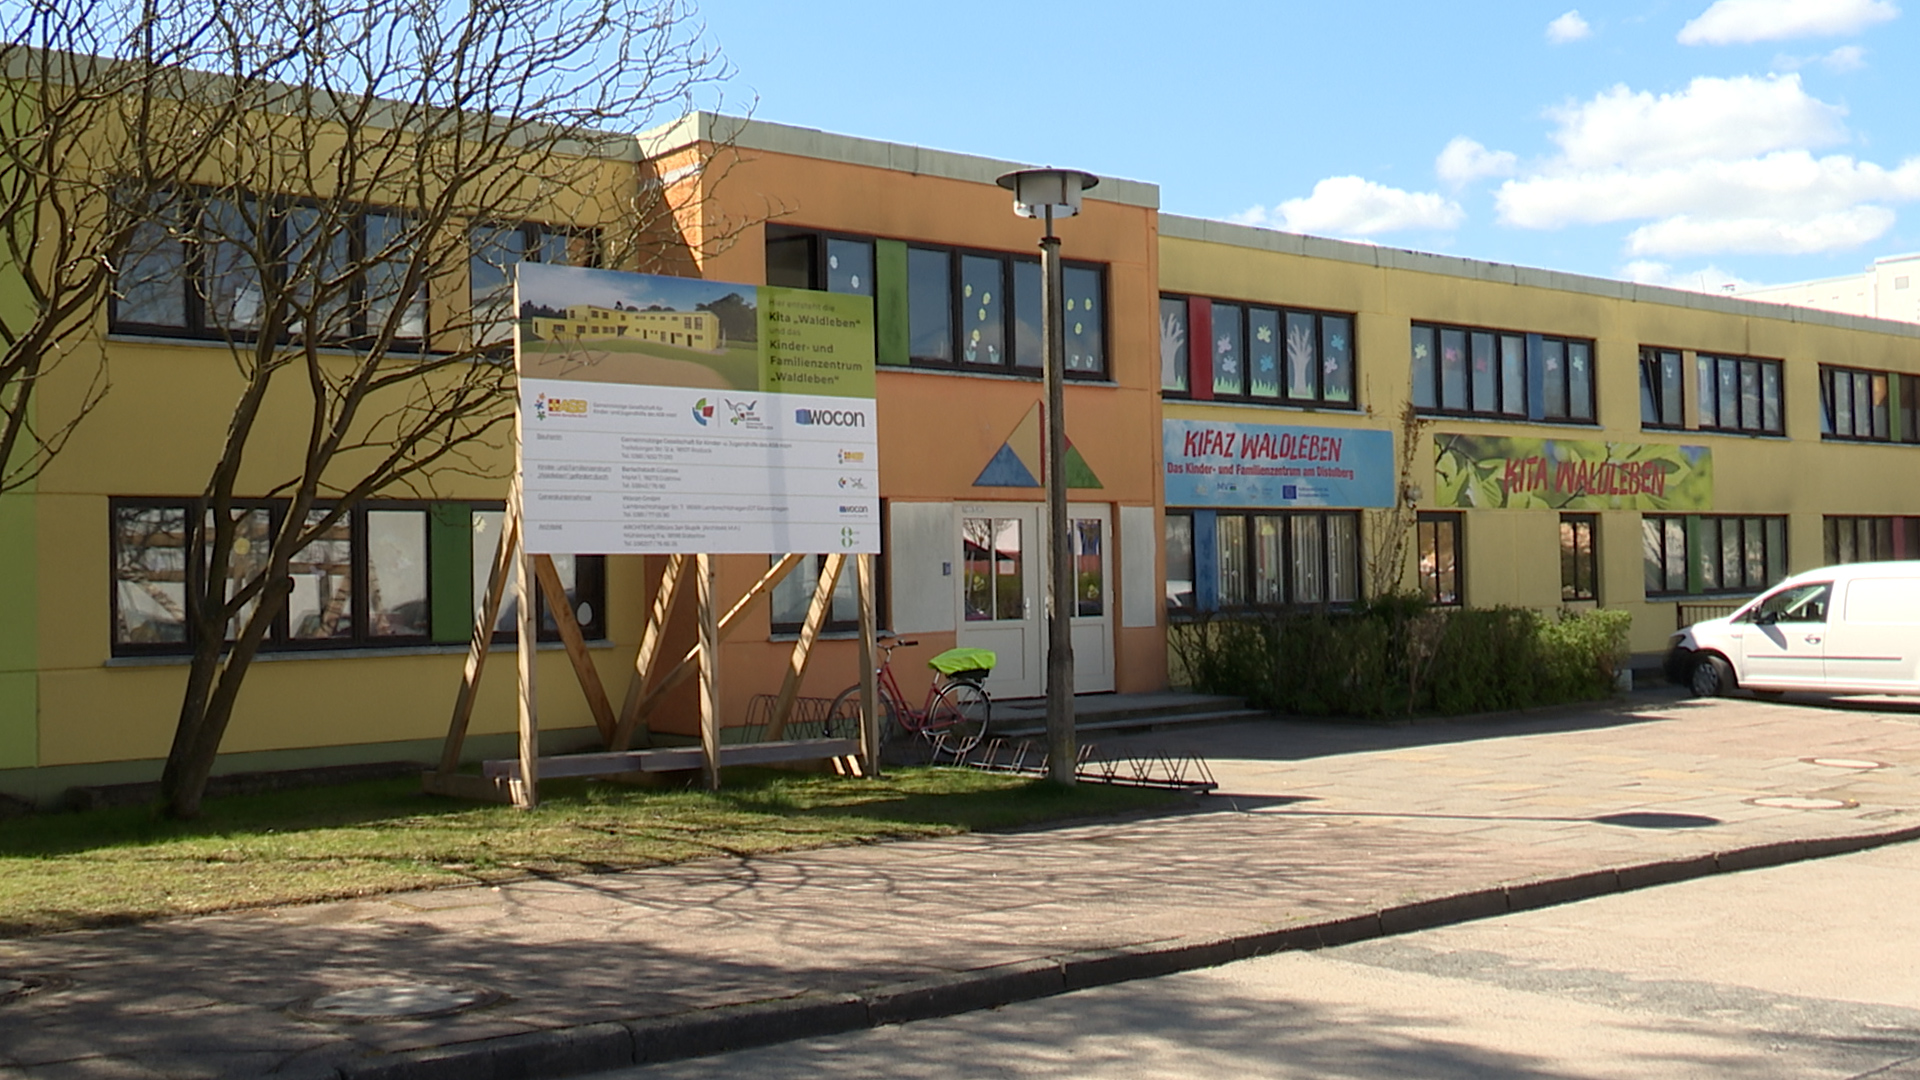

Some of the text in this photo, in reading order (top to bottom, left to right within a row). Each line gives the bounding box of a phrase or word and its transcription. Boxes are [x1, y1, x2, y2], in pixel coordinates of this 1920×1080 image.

[822, 304, 835, 312] die
[769, 311, 791, 322] Kita
[769, 340, 834, 354] Kinder- und
[770, 356, 863, 371] Familienzentrum
[1183, 429, 1342, 462] KIFAZ WALDLEBEN
[1167, 462, 1183, 474] Das
[1185, 462, 1217, 475] Kinder-
[1218, 463, 1234, 475] und
[1236, 464, 1301, 476] Familienzentrum
[1303, 467, 1316, 477] am
[1502, 456, 1666, 498] KITA WALDLEBEN
